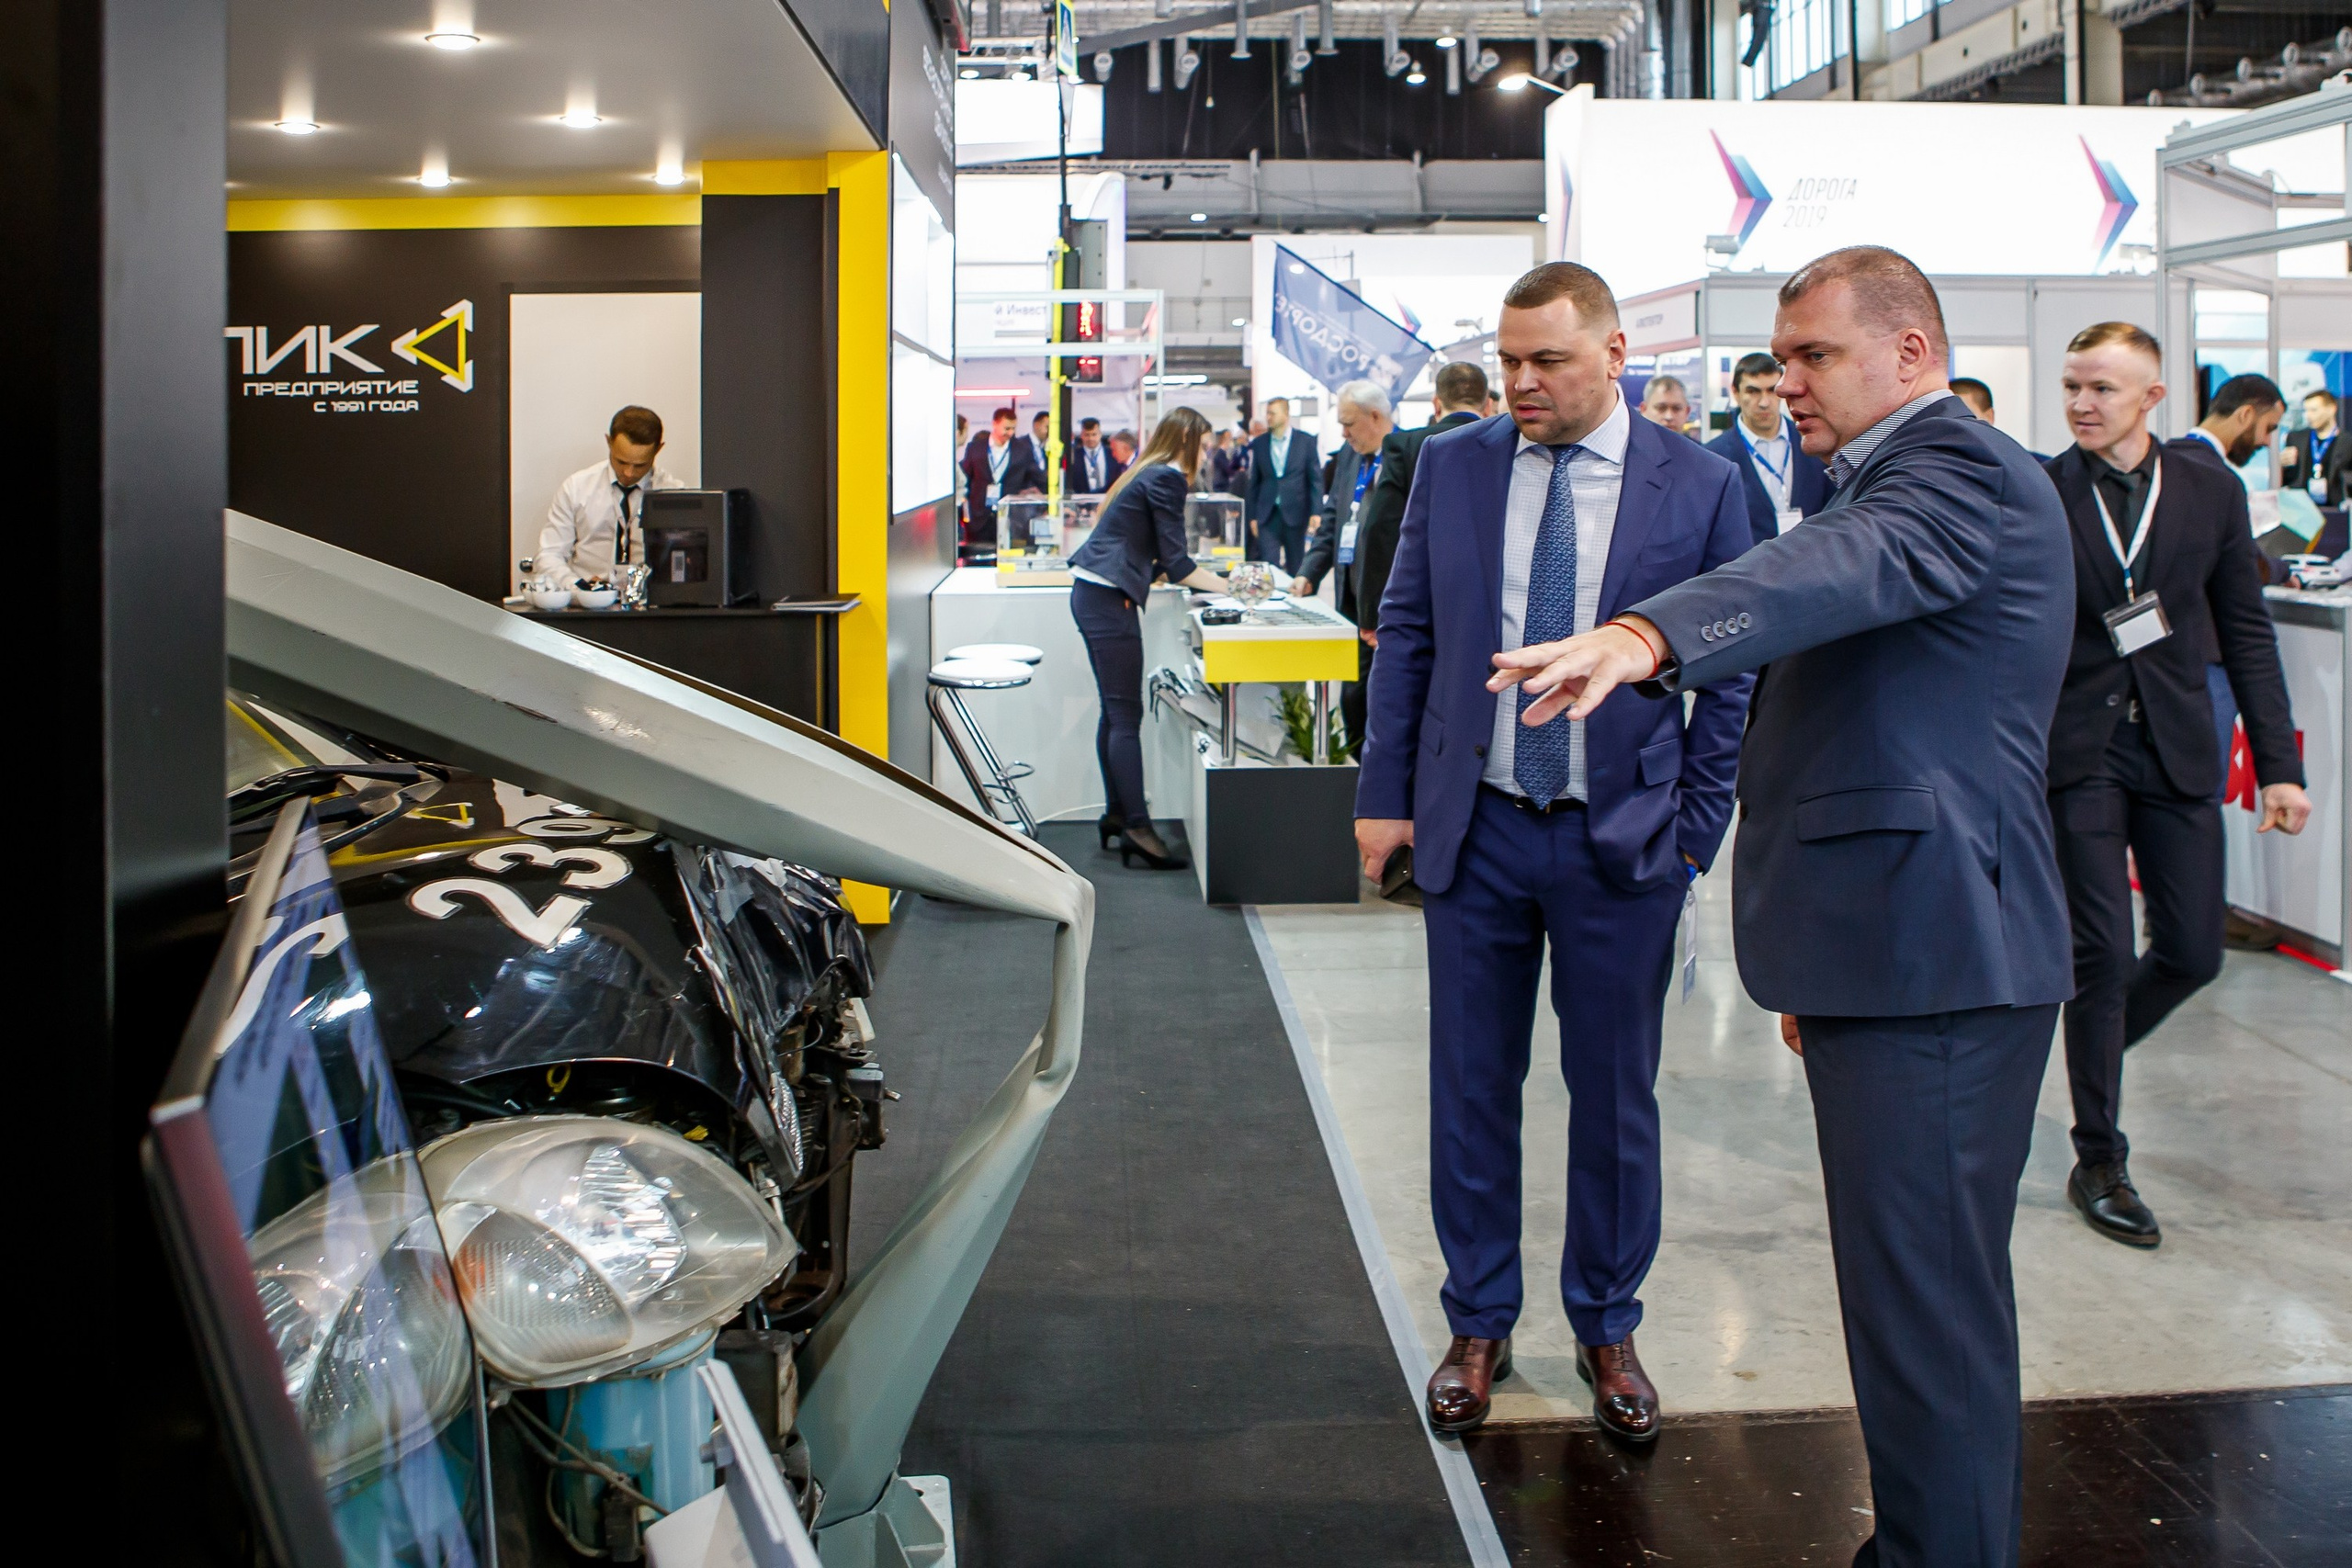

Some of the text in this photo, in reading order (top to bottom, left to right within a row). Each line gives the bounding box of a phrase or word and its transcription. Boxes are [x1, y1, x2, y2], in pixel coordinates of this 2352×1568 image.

[1787, 177, 1857, 201] ДОРОГА
[1783, 205, 1826, 228] 2019
[243, 380, 419, 397] ПРЕДПРИЯТИЕ
[331, 400, 365, 412] 1991
[368, 400, 419, 412] ГОДА
